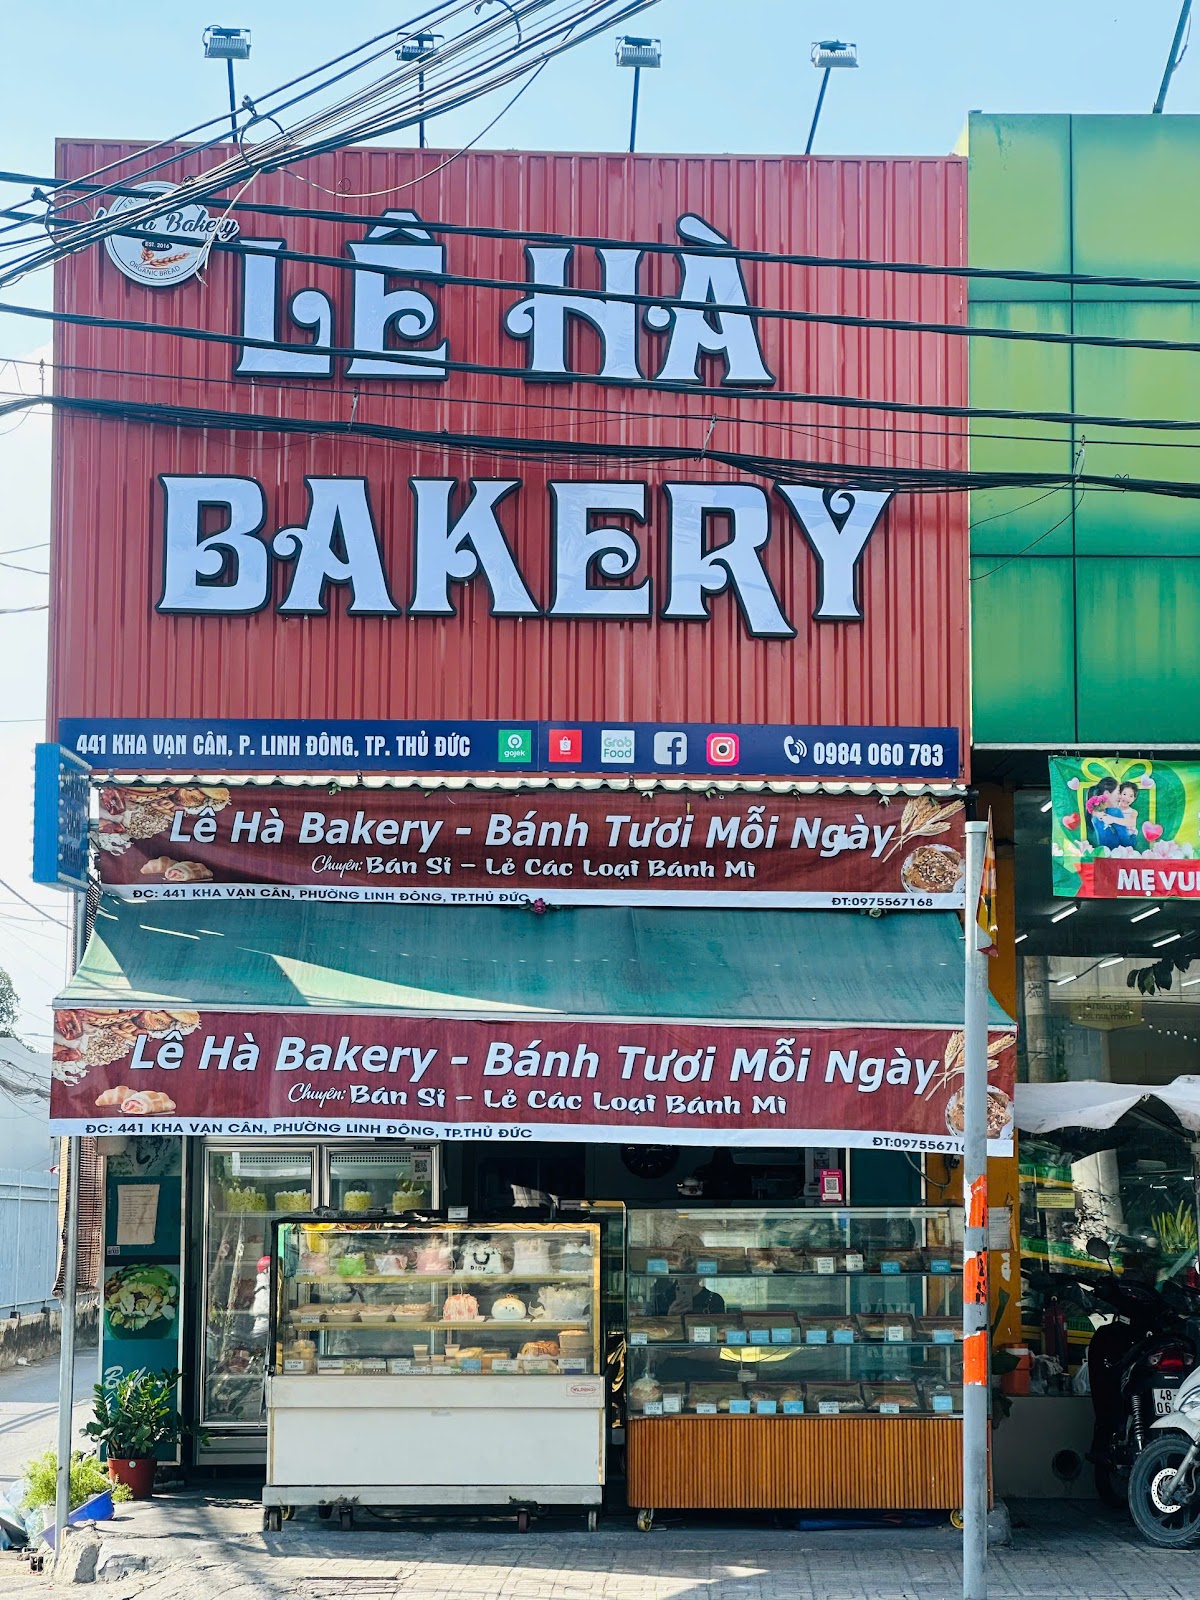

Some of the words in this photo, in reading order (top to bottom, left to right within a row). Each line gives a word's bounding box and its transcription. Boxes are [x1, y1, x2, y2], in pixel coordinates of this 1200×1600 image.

[129, 260, 158, 276] ORGANIC
[159, 265, 181, 276] BREAD
[235, 208, 450, 381] LÊ
[504, 212, 777, 387] HÀ
[156, 474, 896, 639] BAKERY
[76, 734, 107, 756] 441
[112, 735, 148, 756] KHA
[153, 735, 187, 760] VẠN
[192, 731, 233, 758] CÂN,
[239, 735, 256, 756] P.
[261, 735, 300, 756] LINH
[305, 731, 359, 758] ĐÔNG,
[365, 735, 391, 757] TP.
[397, 730, 430, 757] THỦ
[434, 731, 471, 757] ĐỨC
[504, 750, 526, 758] gojek
[603, 737, 633, 748] Grab
[604, 748, 632, 758] Food
[814, 742, 862, 765] 0984
[868, 743, 904, 766] 060
[909, 743, 944, 767] 783
[169, 807, 217, 844] Lê
[230, 807, 285, 845] Hà
[299, 811, 444, 853] Bakery
[485, 809, 590, 849] Bánh
[605, 814, 695, 849] Tươi
[705, 805, 778, 849] Mỗi
[790, 814, 896, 858] Ngày
[312, 855, 362, 878] Chuyên:
[366, 856, 417, 875] Bán
[485, 857, 516, 875] Lẻ
[524, 858, 574, 876] Các
[583, 859, 640, 880] Loại
[648, 859, 715, 877] Bánh
[724, 860, 756, 878] Mì
[133, 888, 160, 899] ĐC:
[162, 888, 188, 898] 441
[192, 888, 223, 898] KHA
[226, 888, 257, 901] VẠN
[259, 886, 295, 901] CÂN,
[300, 889, 360, 900] PHƯỜNG
[364, 892, 395, 901] LINH
[400, 891, 447, 903] ĐÔNG,
[451, 890, 494, 902] TP.THỦ
[499, 891, 529, 902] ĐỨC
[1117, 868, 1156, 896] MẸ
[832, 897, 933, 907] ĐT:0975567168
[130, 1030, 185, 1070] Lê
[198, 1031, 260, 1072] Hà
[274, 1035, 439, 1082] Bakery
[482, 1039, 598, 1080] Bánh
[616, 1045, 717, 1083] Tươi
[730, 1038, 810, 1084] Mỗi
[825, 1047, 940, 1095] Ngày
[287, 1083, 346, 1108] Chuyên:
[350, 1085, 408, 1105] Bán
[483, 1088, 518, 1109] Lẻ
[527, 1090, 583, 1110] Các
[593, 1091, 657, 1116] Loại
[665, 1095, 741, 1115] Bánh
[751, 1095, 787, 1115] Mì
[86, 1123, 113, 1135] ĐC:
[117, 1123, 145, 1134] 441
[151, 1122, 185, 1134] KHA
[189, 1122, 224, 1137] VẠN
[227, 1119, 268, 1135] CÂN,
[273, 1120, 341, 1133] PHƯỜNG
[346, 1123, 381, 1134] LINH
[386, 1122, 439, 1138] ĐÔNG,
[444, 1124, 493, 1138] TP.THỦ
[498, 1125, 533, 1138] ĐỨC
